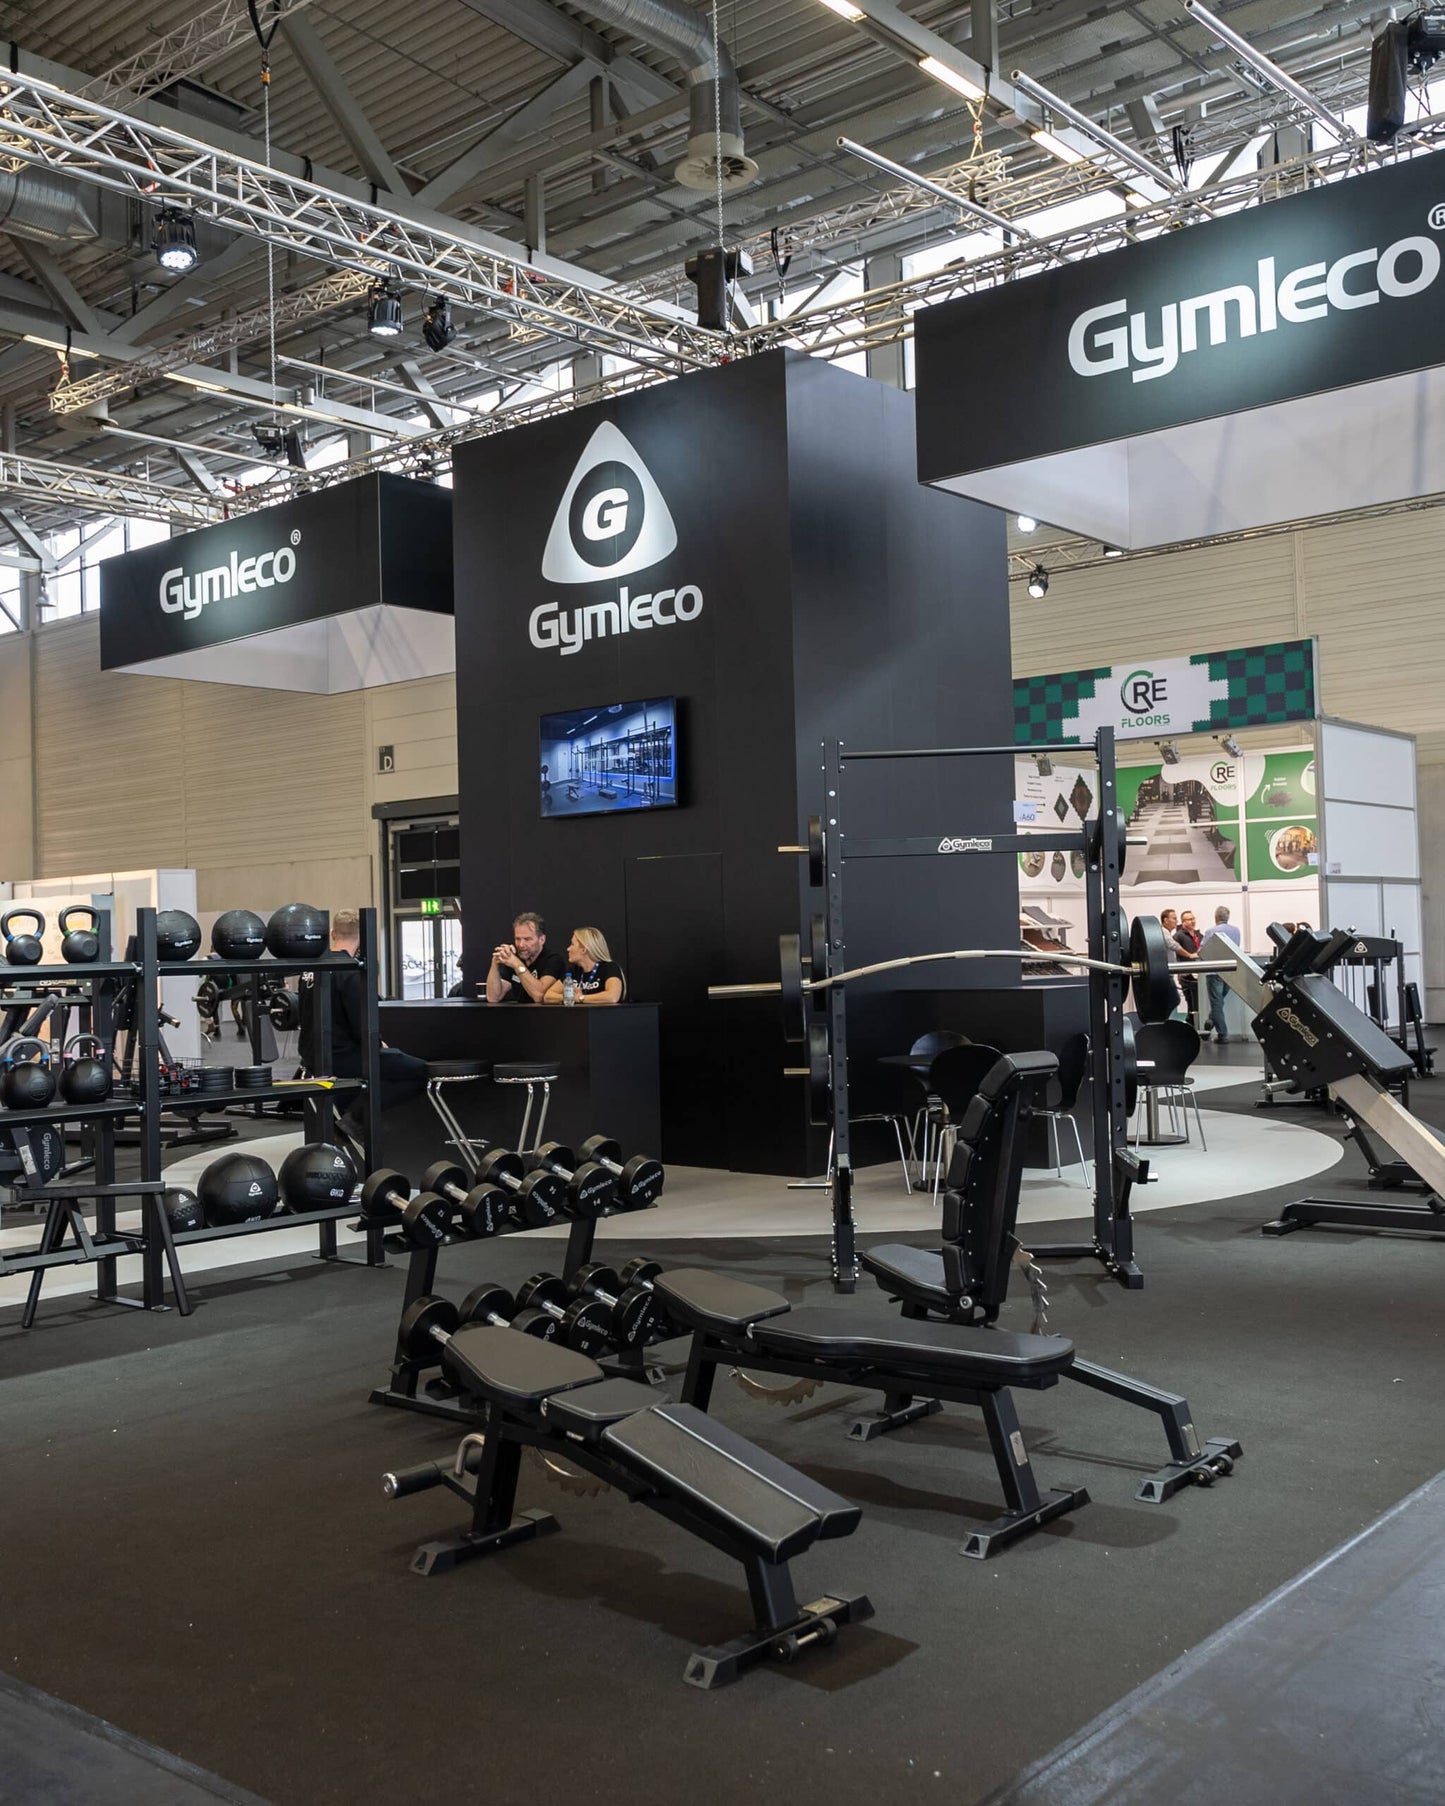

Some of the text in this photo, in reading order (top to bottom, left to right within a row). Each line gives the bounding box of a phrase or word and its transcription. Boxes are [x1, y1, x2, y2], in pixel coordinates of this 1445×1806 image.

[1068, 236, 1441, 383] Gymleco
[582, 487, 629, 541] G
[159, 547, 296, 620] Gymleco
[529, 585, 704, 656] Gymleco
[1121, 714, 1170, 728] FLOORS
[952, 839, 992, 851] Gymleco
[42, 1132, 52, 1170] Gymleco
